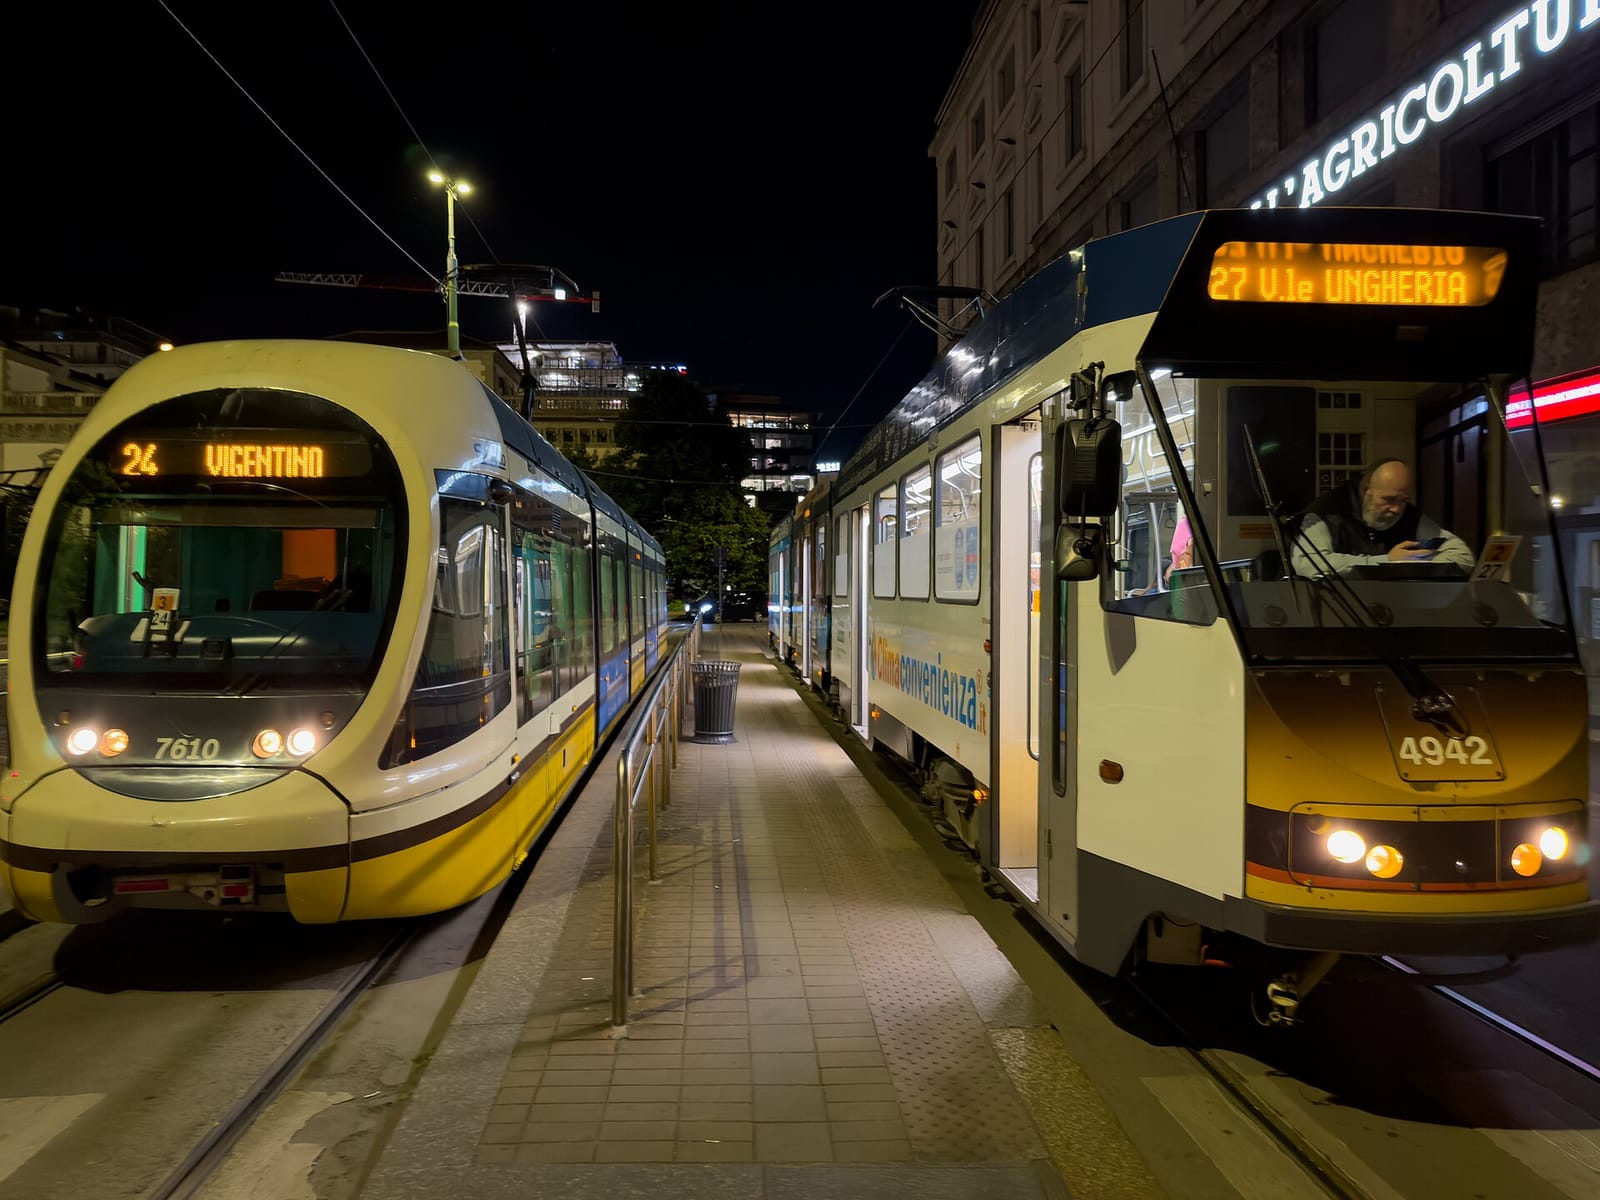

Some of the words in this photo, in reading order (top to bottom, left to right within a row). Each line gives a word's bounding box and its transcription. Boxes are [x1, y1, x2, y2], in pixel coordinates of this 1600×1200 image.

[1210, 266, 1248, 300] 27
[1325, 268, 1467, 304] UNGHERIA
[122, 443, 159, 476] 24
[205, 444, 323, 478] VIGENTINO
[1477, 563, 1503, 578] 27
[158, 596, 167, 609] 3
[151, 612, 168, 626] 24
[154, 737, 220, 760] 7610
[1399, 736, 1494, 766] 4942
